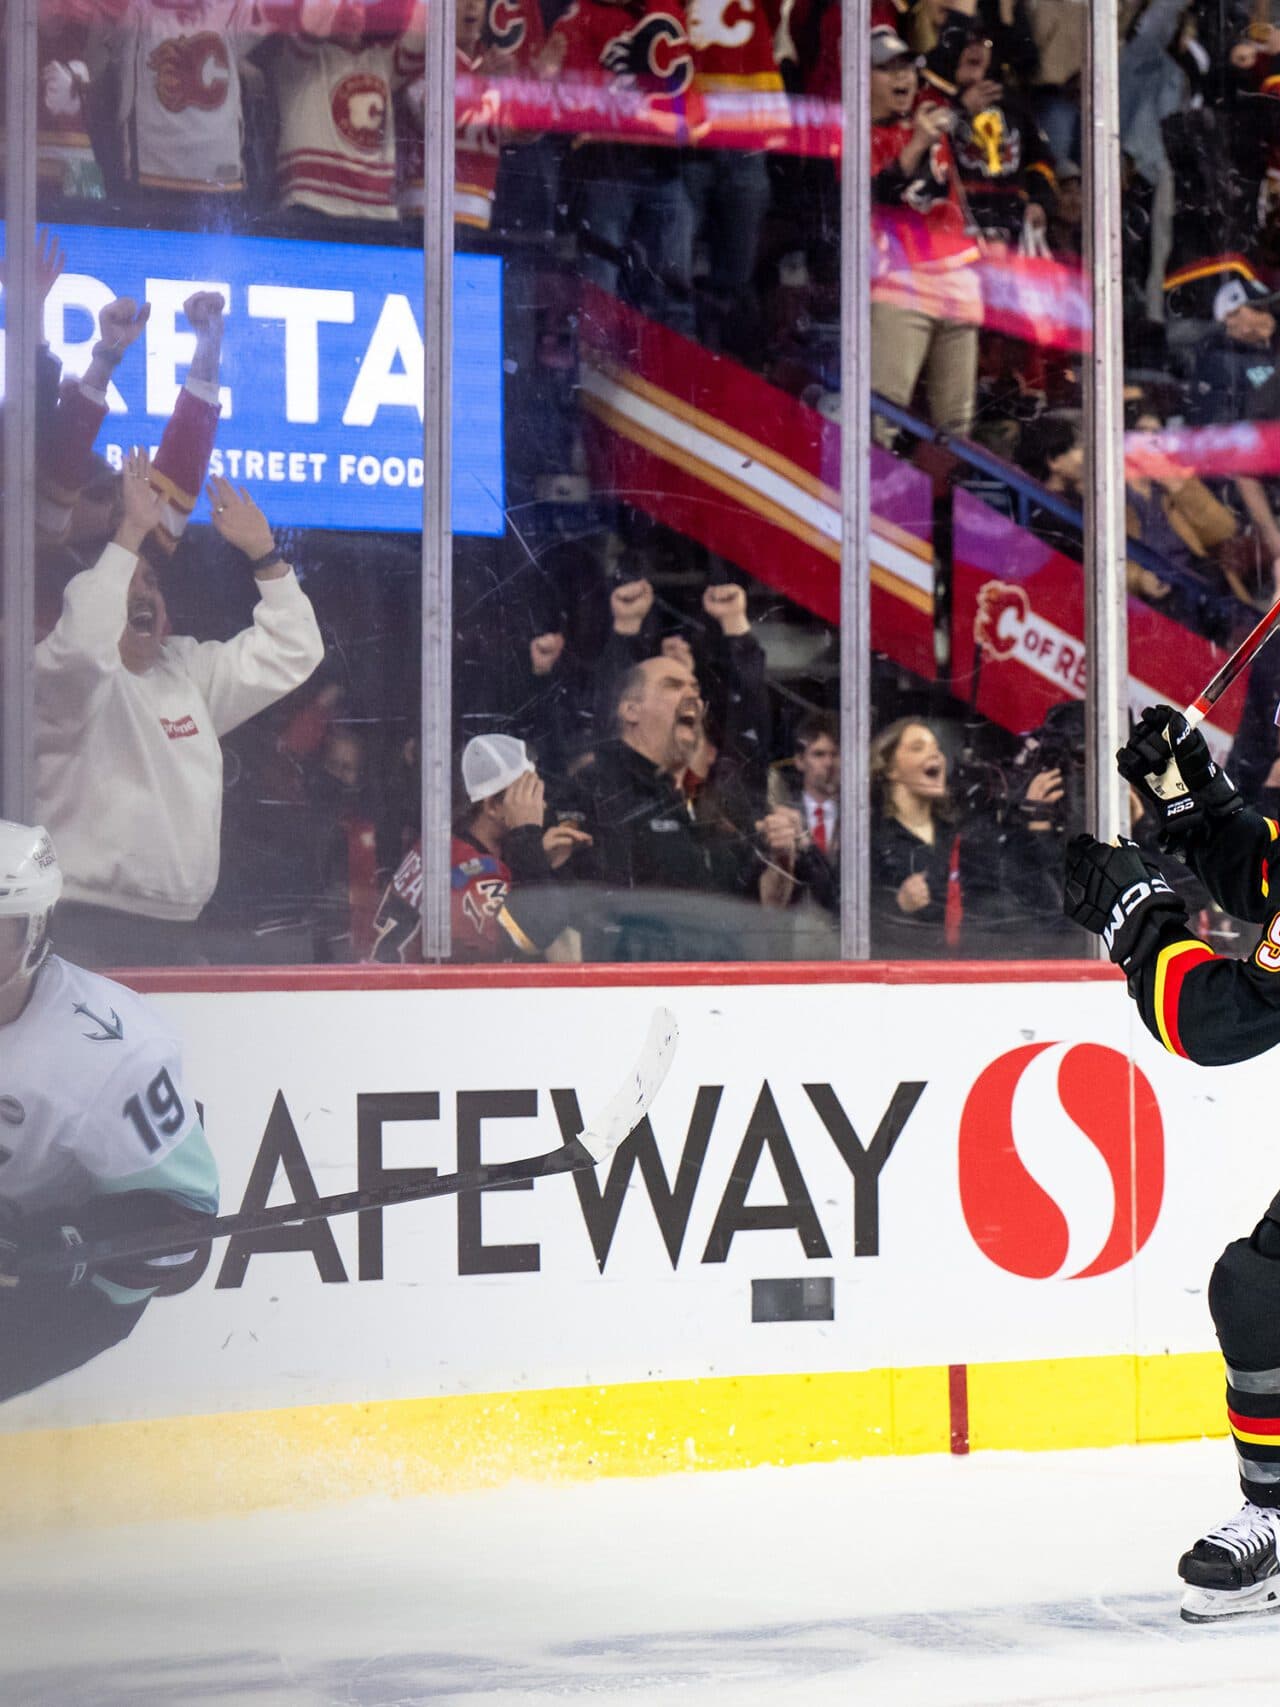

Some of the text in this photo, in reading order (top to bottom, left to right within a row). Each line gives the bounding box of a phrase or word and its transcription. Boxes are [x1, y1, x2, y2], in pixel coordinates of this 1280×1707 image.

[2, 272, 425, 426] RETA
[208, 449, 425, 488] STREET FOOD
[1024, 629, 1056, 658] OF
[1055, 644, 1087, 690] RE
[122, 1065, 185, 1154] 19
[195, 1078, 929, 1289] AFEWAY
